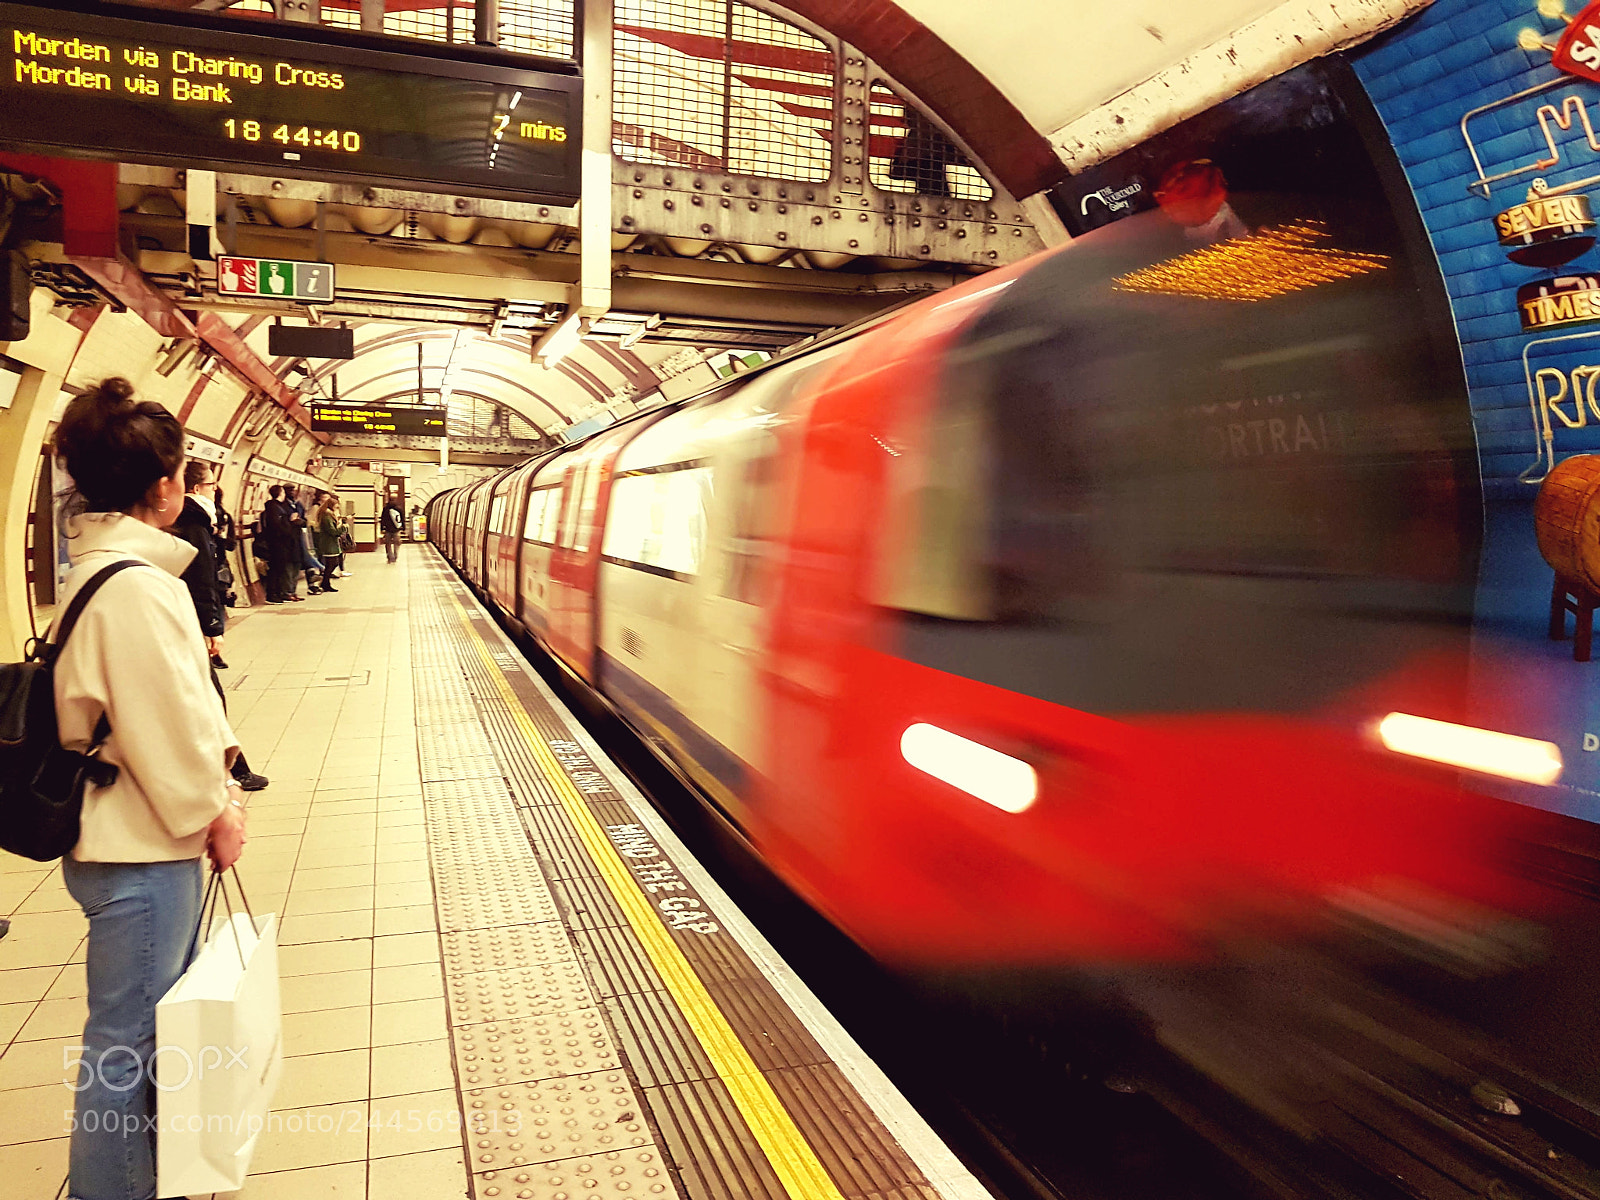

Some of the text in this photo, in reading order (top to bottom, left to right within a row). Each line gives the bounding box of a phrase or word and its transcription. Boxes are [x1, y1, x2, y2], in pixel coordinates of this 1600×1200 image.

[14, 30, 345, 90] Morden via Charing Cross
[15, 58, 111, 90] Morden
[124, 73, 160, 96] via
[172, 77, 233, 104] Bank
[520, 120, 567, 142] mins
[224, 118, 361, 152] 18 44:40
[1497, 196, 1585, 237] SEVEN
[1523, 290, 1600, 325] TIMES
[606, 823, 720, 935] MIND THE GAP
